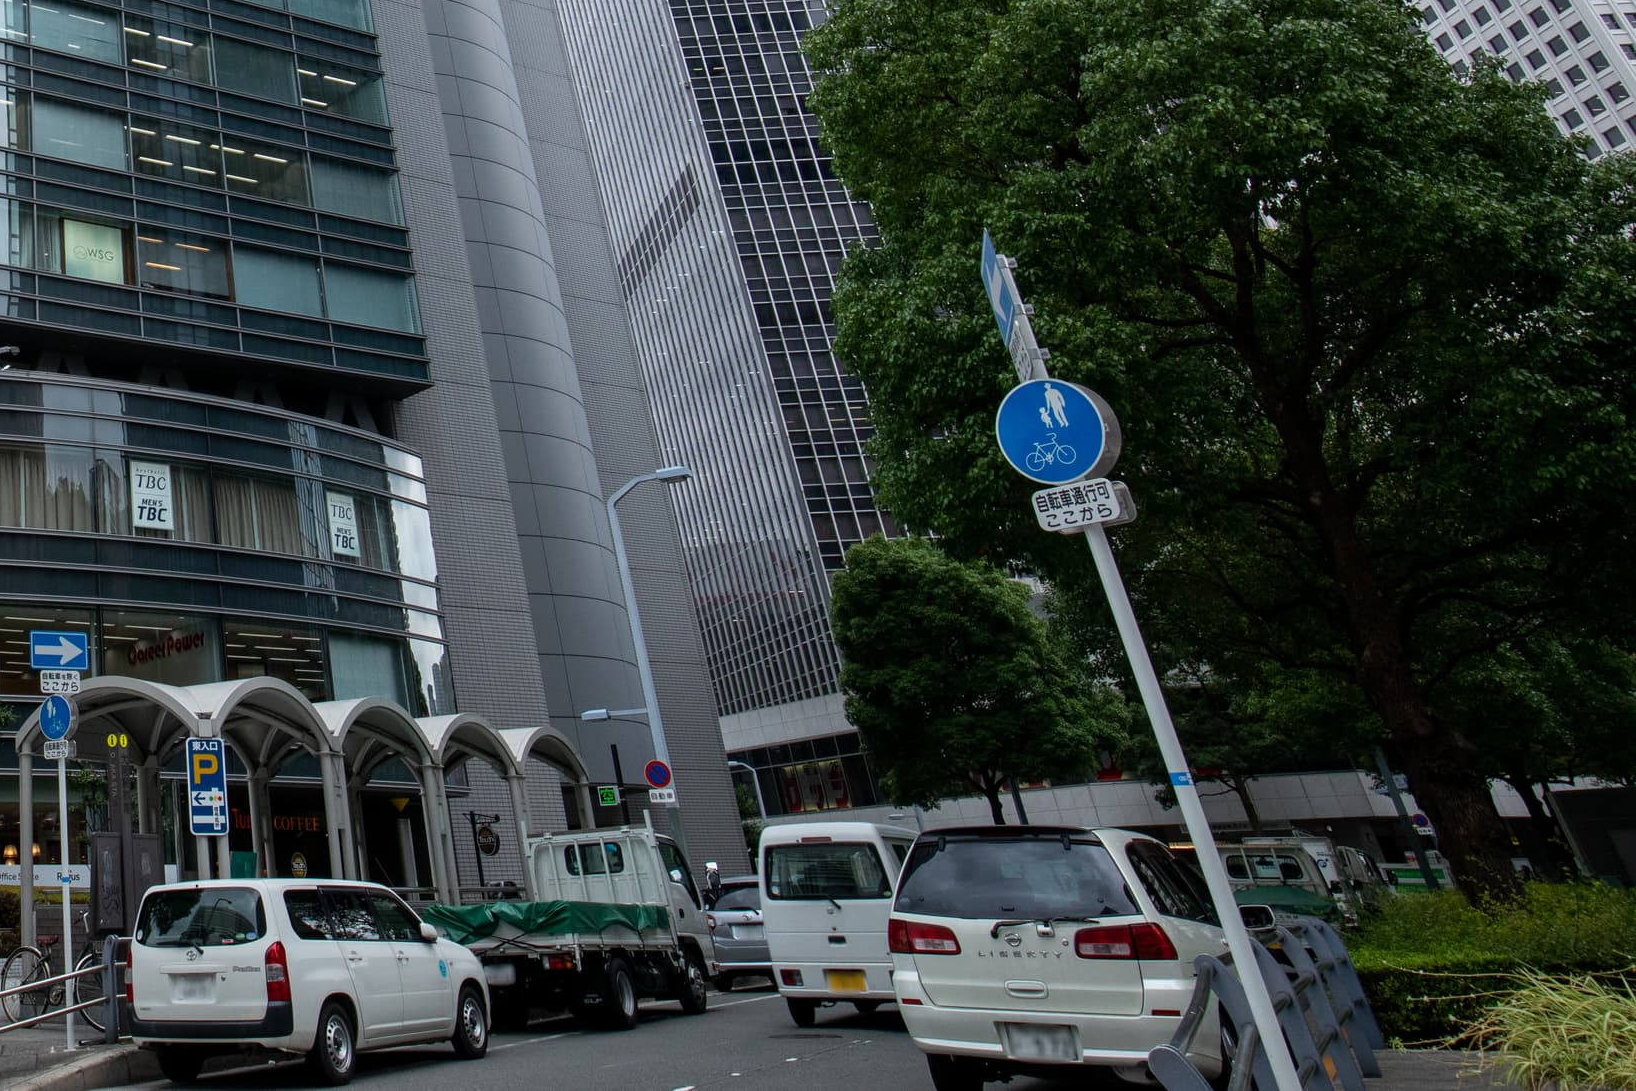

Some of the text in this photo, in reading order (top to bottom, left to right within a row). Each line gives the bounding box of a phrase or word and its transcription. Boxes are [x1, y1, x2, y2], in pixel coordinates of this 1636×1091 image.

[86, 247, 114, 262] WSG
[135, 473, 167, 491] TBC
[141, 498, 164, 508] MEN'S
[1035, 481, 1111, 513] 自転車通行可
[137, 505, 168, 523] TBC
[330, 503, 354, 521] TBC
[1046, 503, 1113, 528] ここから
[334, 533, 356, 551] TBC
[42, 681, 79, 692] ここから
[192, 741, 218, 751] 東入口
[192, 753, 219, 785] P
[273, 815, 319, 831] COFFEE
[978, 950, 1063, 959] LIBERTY
